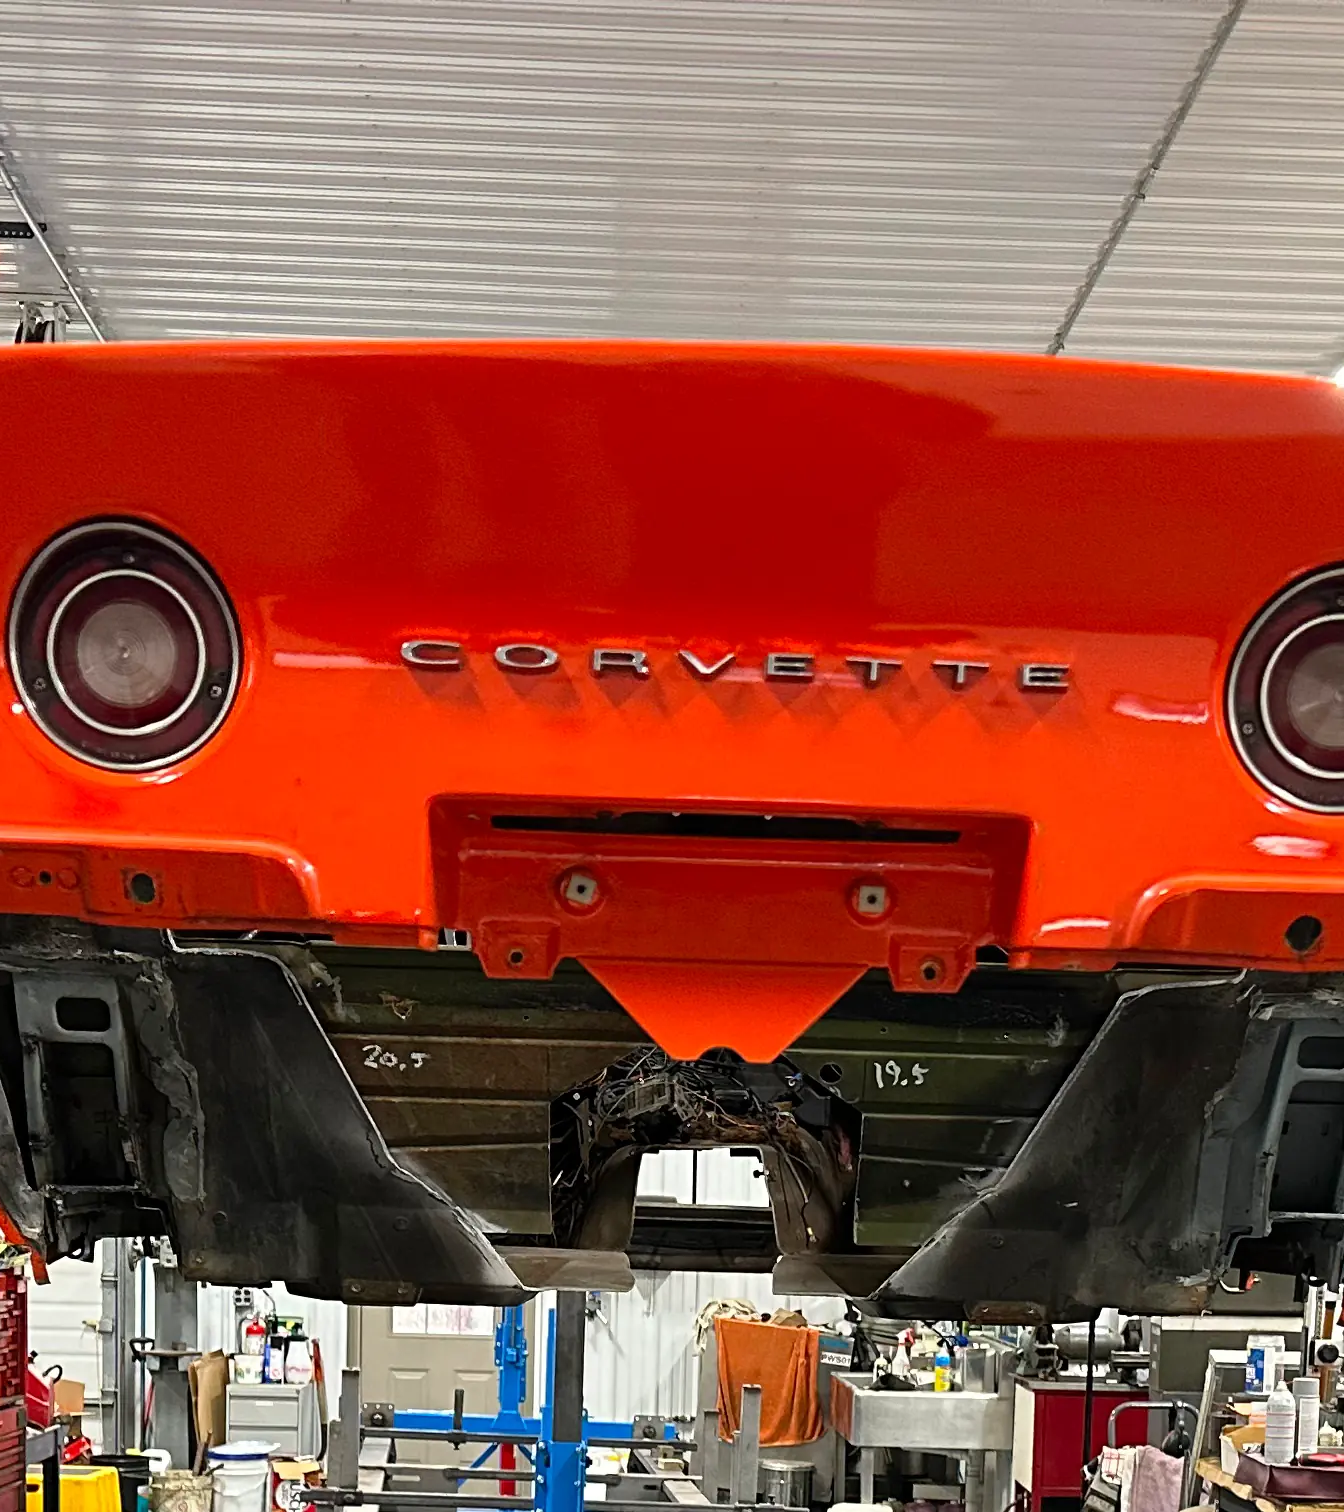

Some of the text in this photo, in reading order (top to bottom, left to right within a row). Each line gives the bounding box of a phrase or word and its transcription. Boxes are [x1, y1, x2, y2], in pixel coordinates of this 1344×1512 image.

[400, 639, 1070, 691] CORVETTE
[361, 1043, 431, 1073] 20.5
[872, 1061, 930, 1089] 19.5
